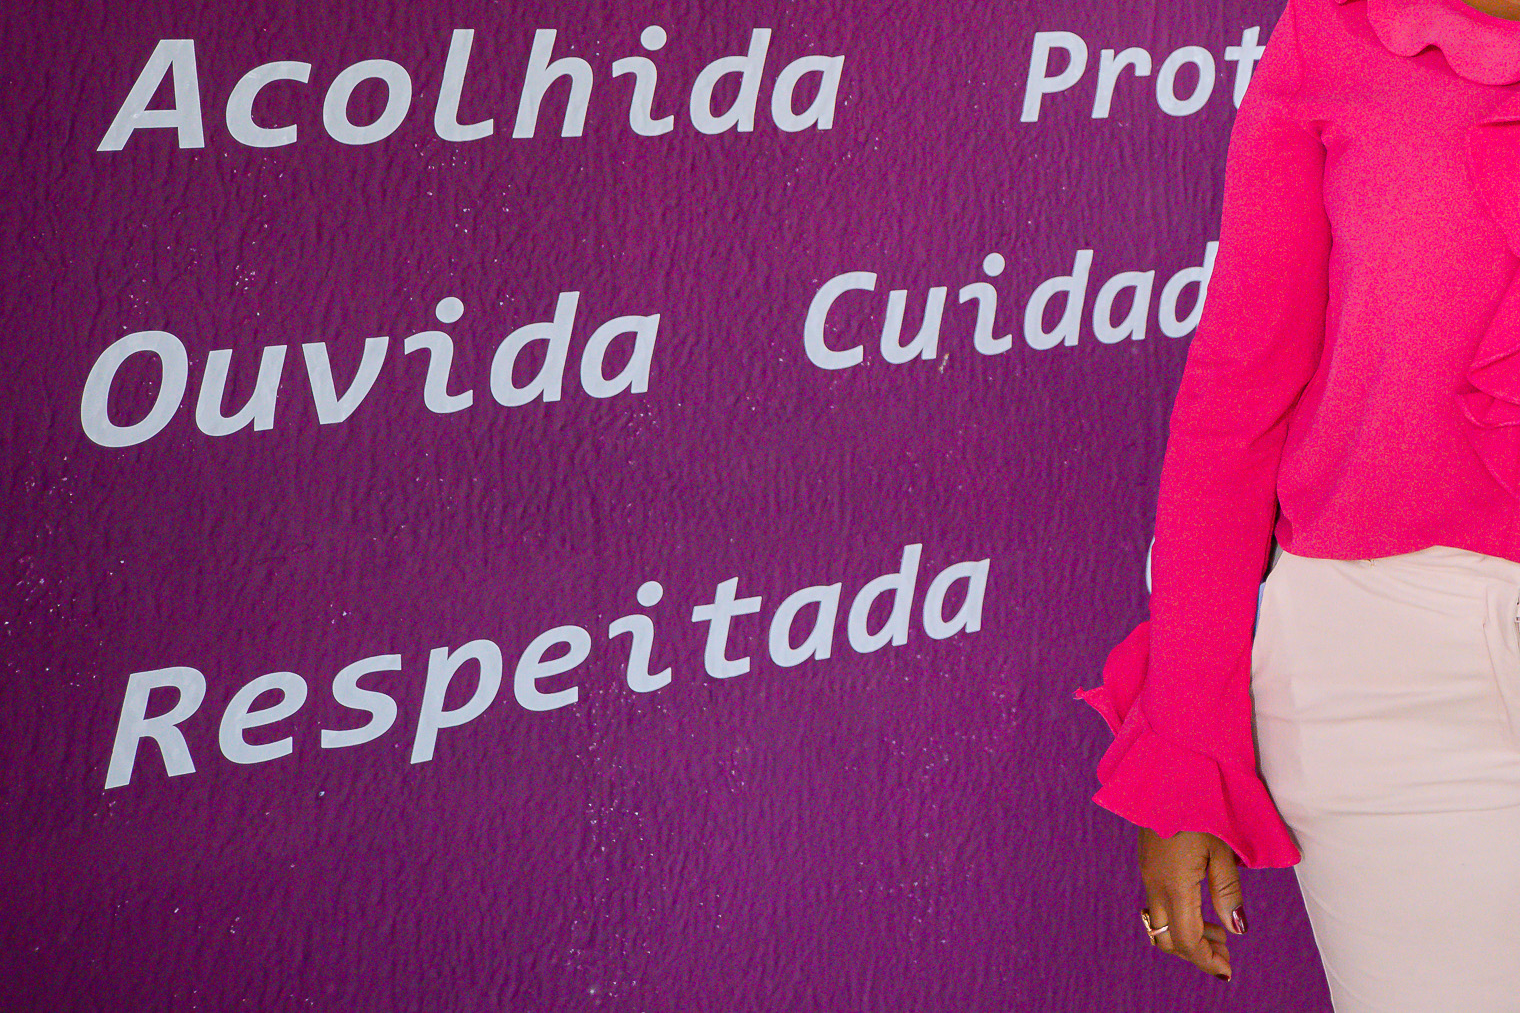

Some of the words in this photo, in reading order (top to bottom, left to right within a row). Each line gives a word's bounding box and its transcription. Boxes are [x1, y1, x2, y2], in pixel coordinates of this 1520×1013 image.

[97, 27, 846, 153] Acolhida
[80, 290, 661, 448] Ouvida
[804, 241, 1219, 370] Cuidad
[105, 543, 990, 789] Respeitada
